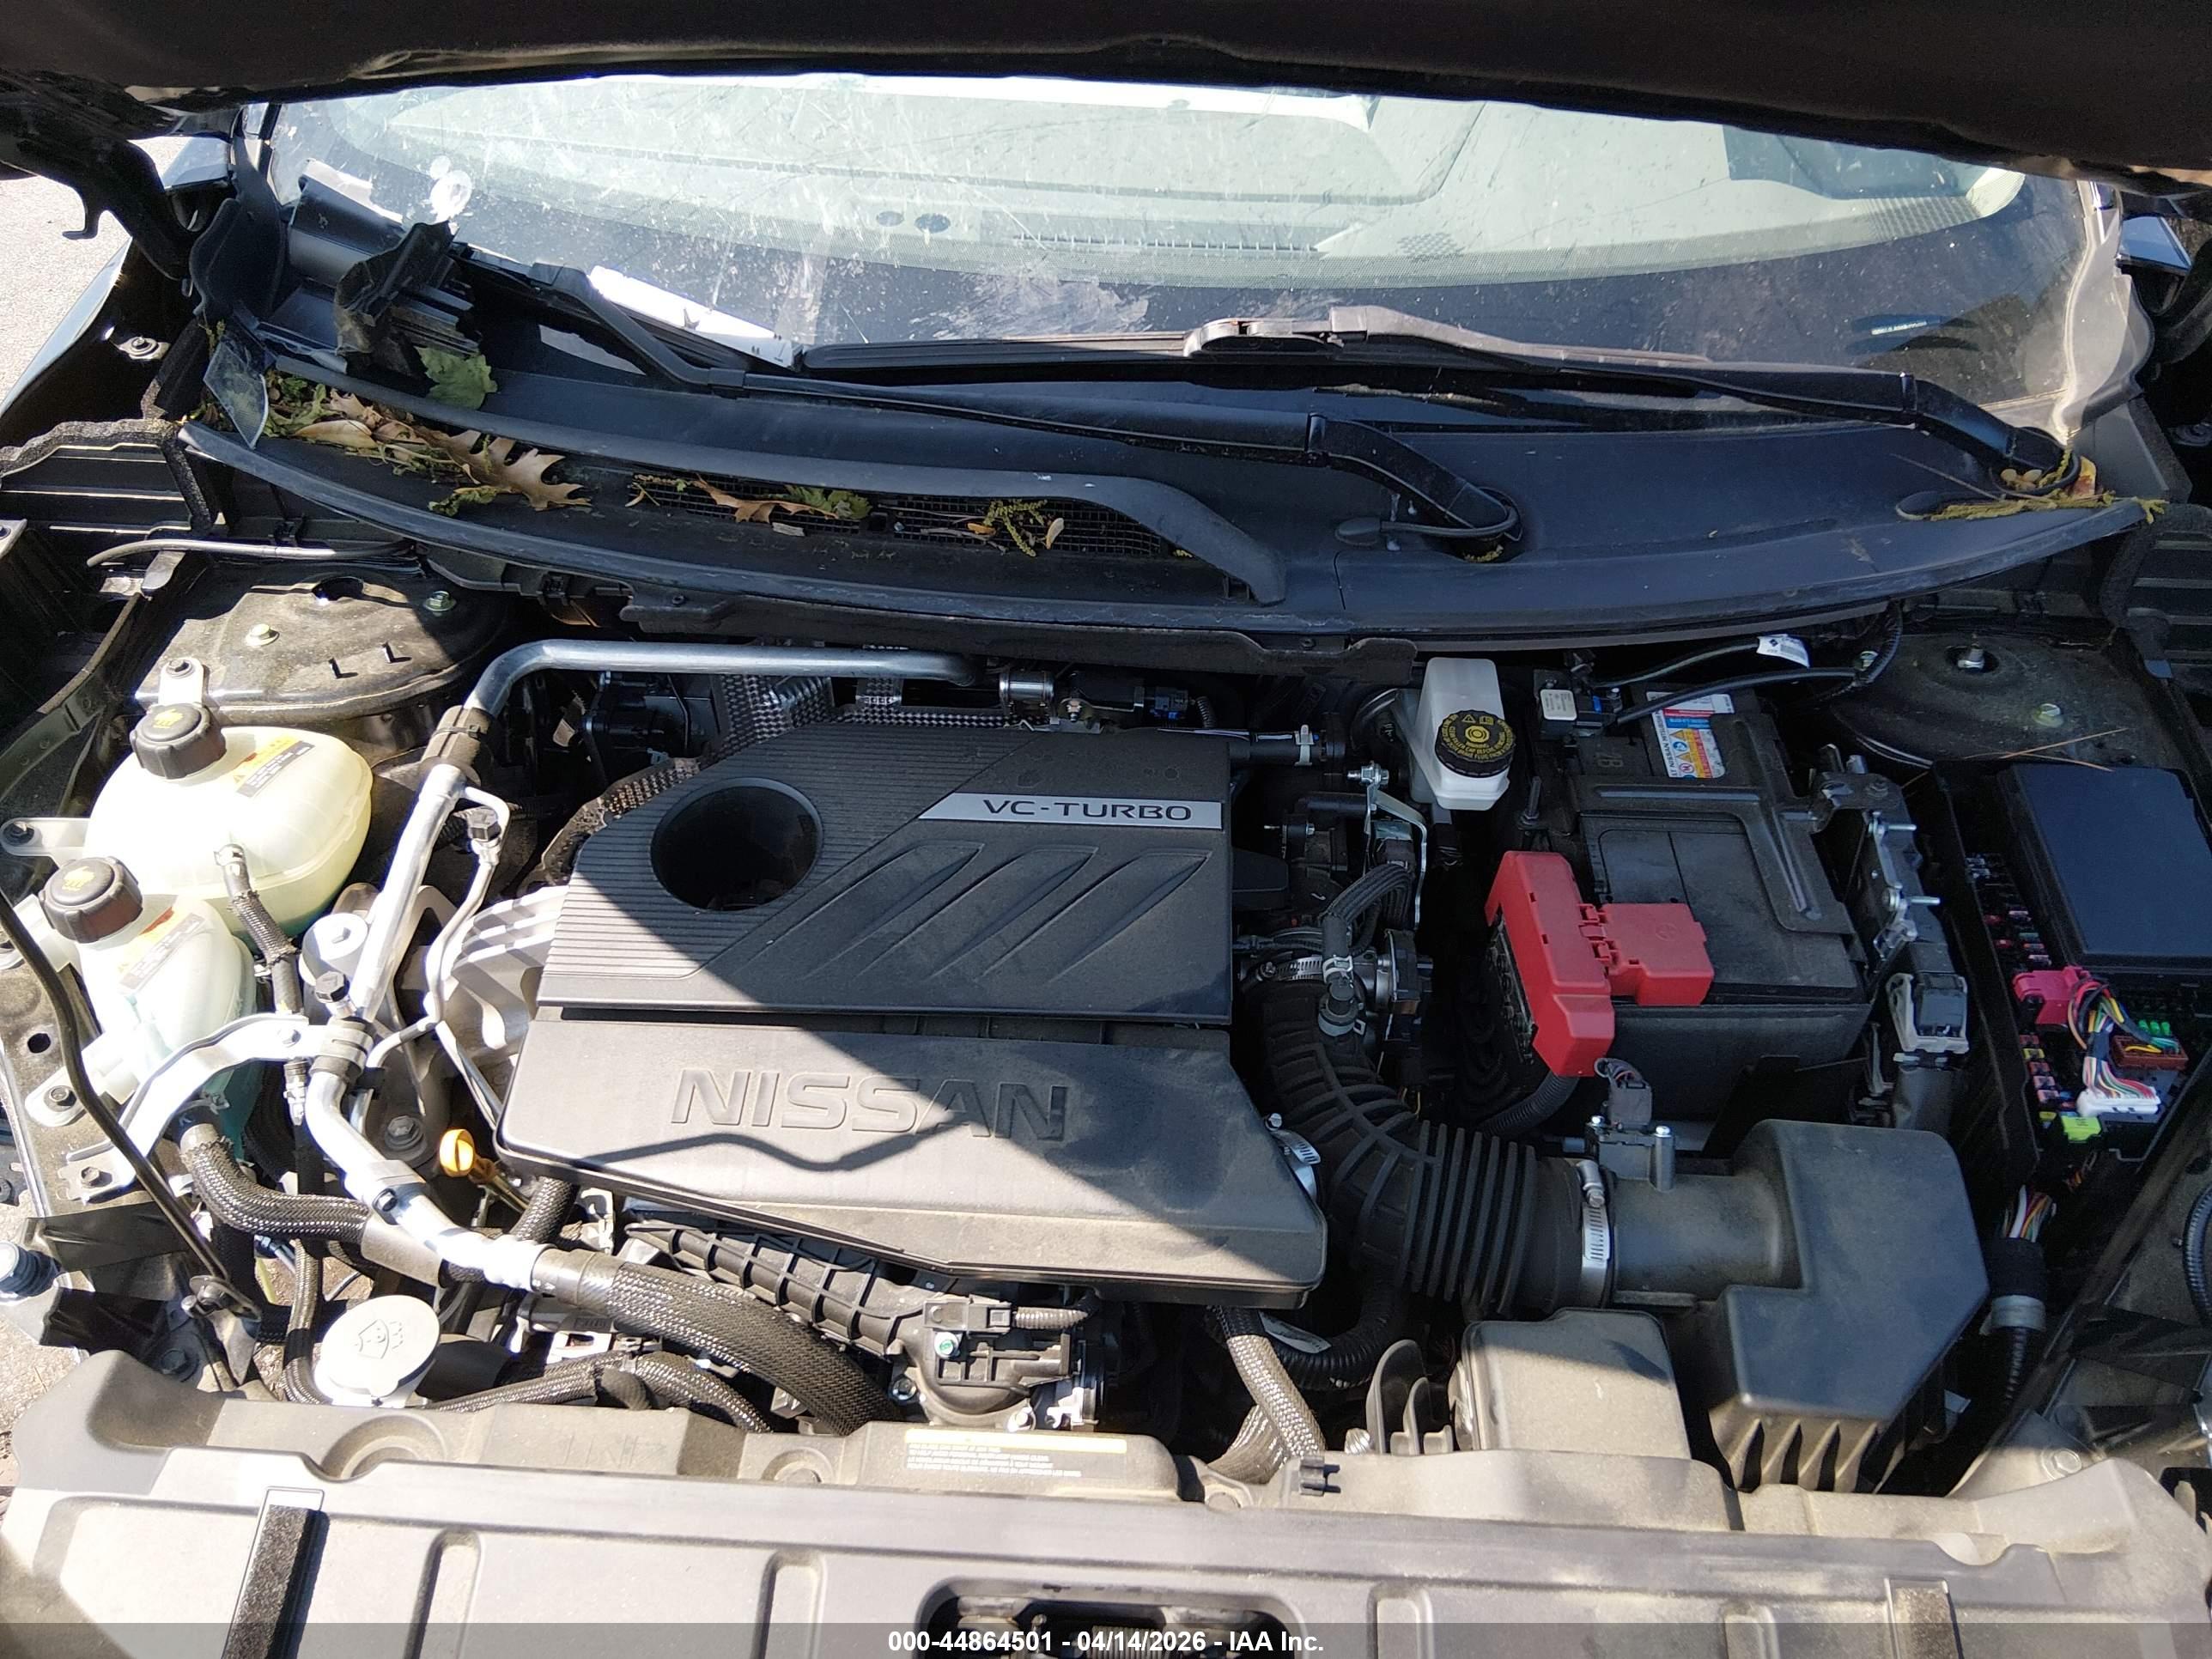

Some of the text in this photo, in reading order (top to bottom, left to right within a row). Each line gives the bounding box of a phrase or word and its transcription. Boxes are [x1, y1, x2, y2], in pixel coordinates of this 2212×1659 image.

[1663, 743, 1675, 769] NISSAN
[983, 799, 1192, 821] VC-TURBO
[671, 1069, 1066, 1141] NISSAN
